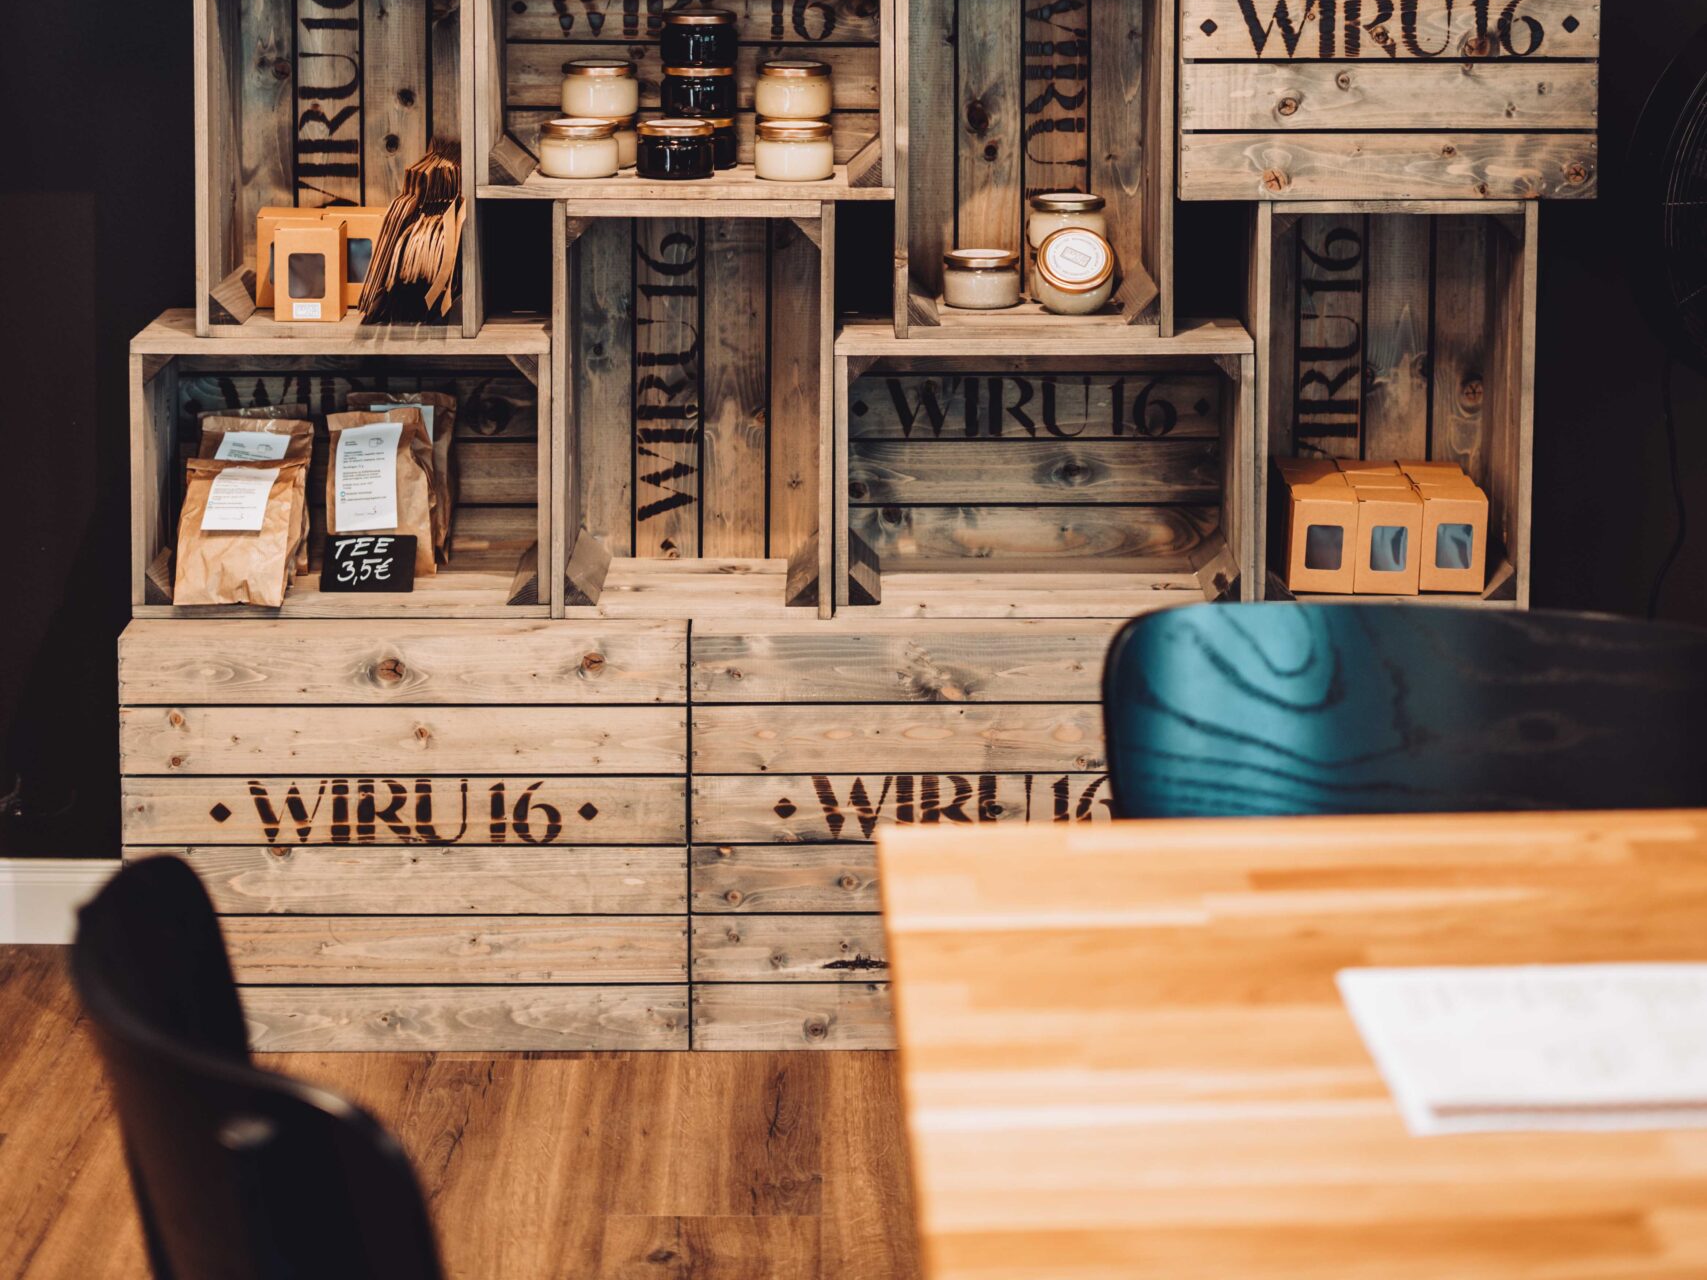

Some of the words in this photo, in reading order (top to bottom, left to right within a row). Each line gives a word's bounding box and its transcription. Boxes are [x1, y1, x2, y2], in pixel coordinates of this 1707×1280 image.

[1300, 314, 1361, 456] IRU
[335, 537, 395, 559] TEE
[337, 558, 394, 586] 3,5€
